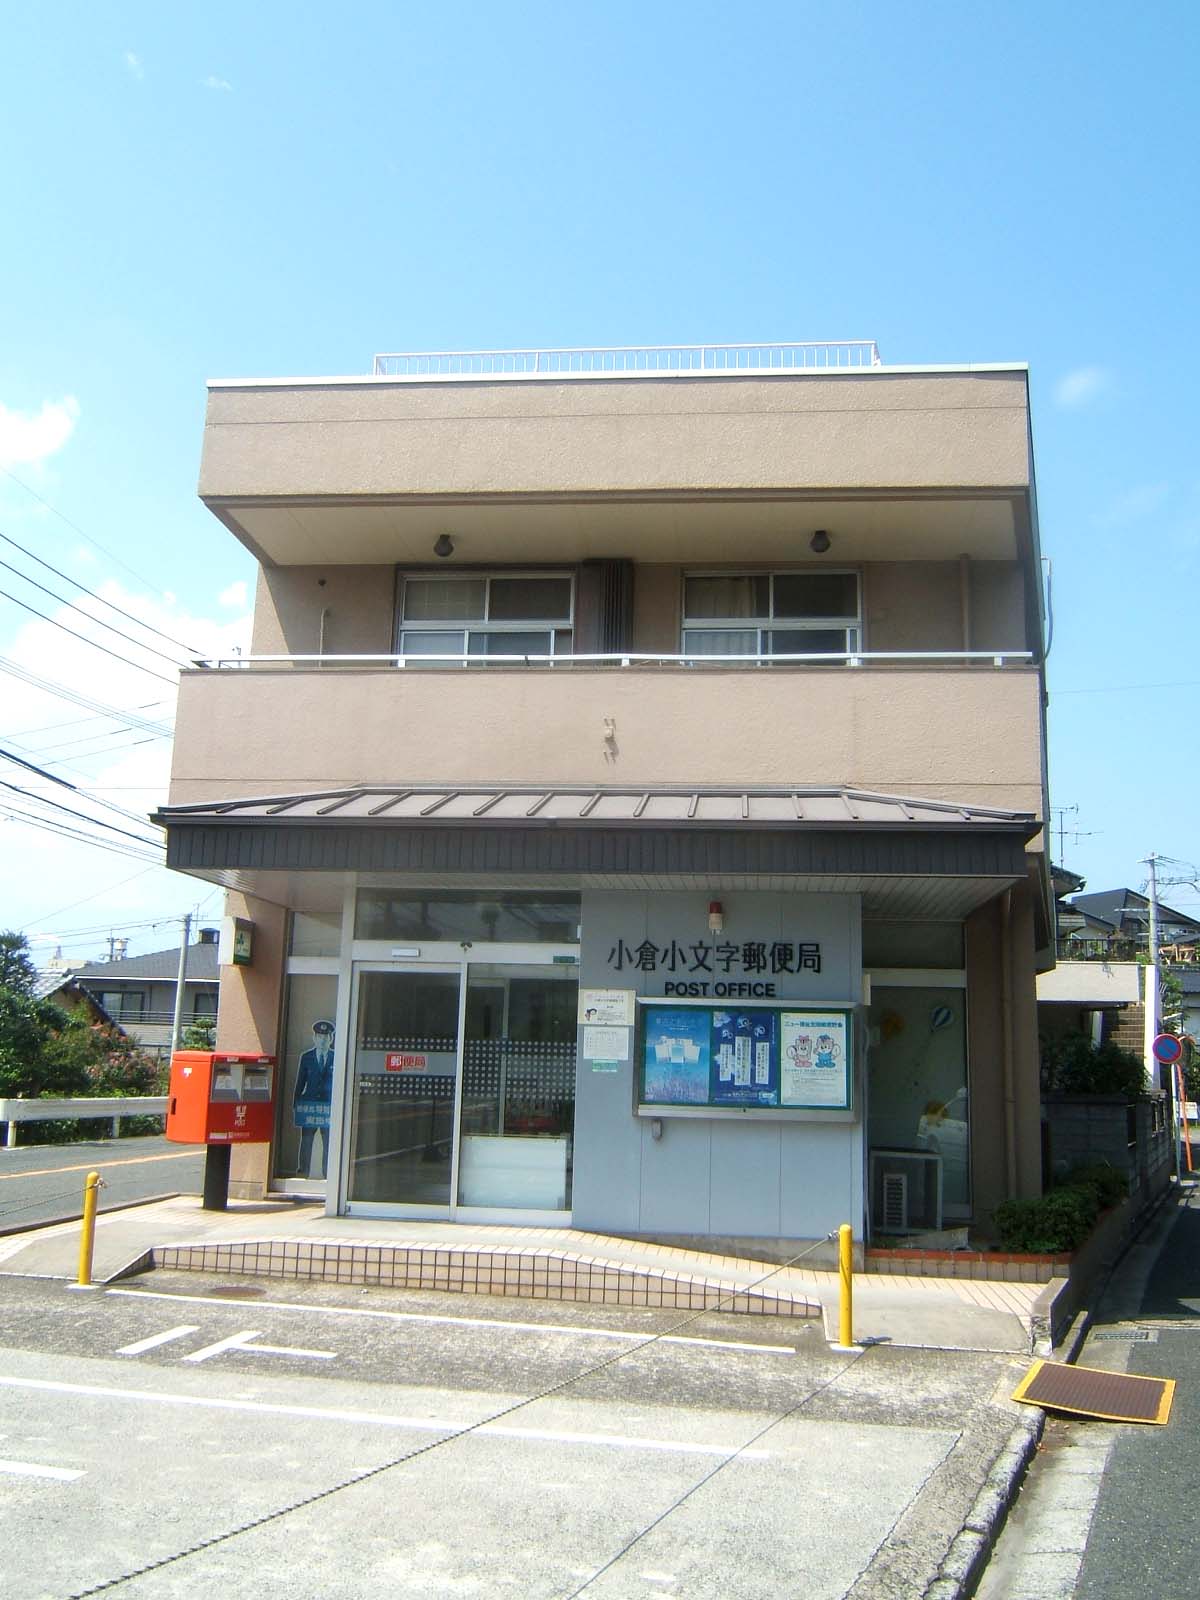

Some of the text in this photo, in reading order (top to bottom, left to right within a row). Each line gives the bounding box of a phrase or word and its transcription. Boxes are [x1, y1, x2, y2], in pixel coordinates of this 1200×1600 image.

[607, 939, 822, 974] 小倉小文字郵便局
[664, 981, 776, 998] POST OFFICE
